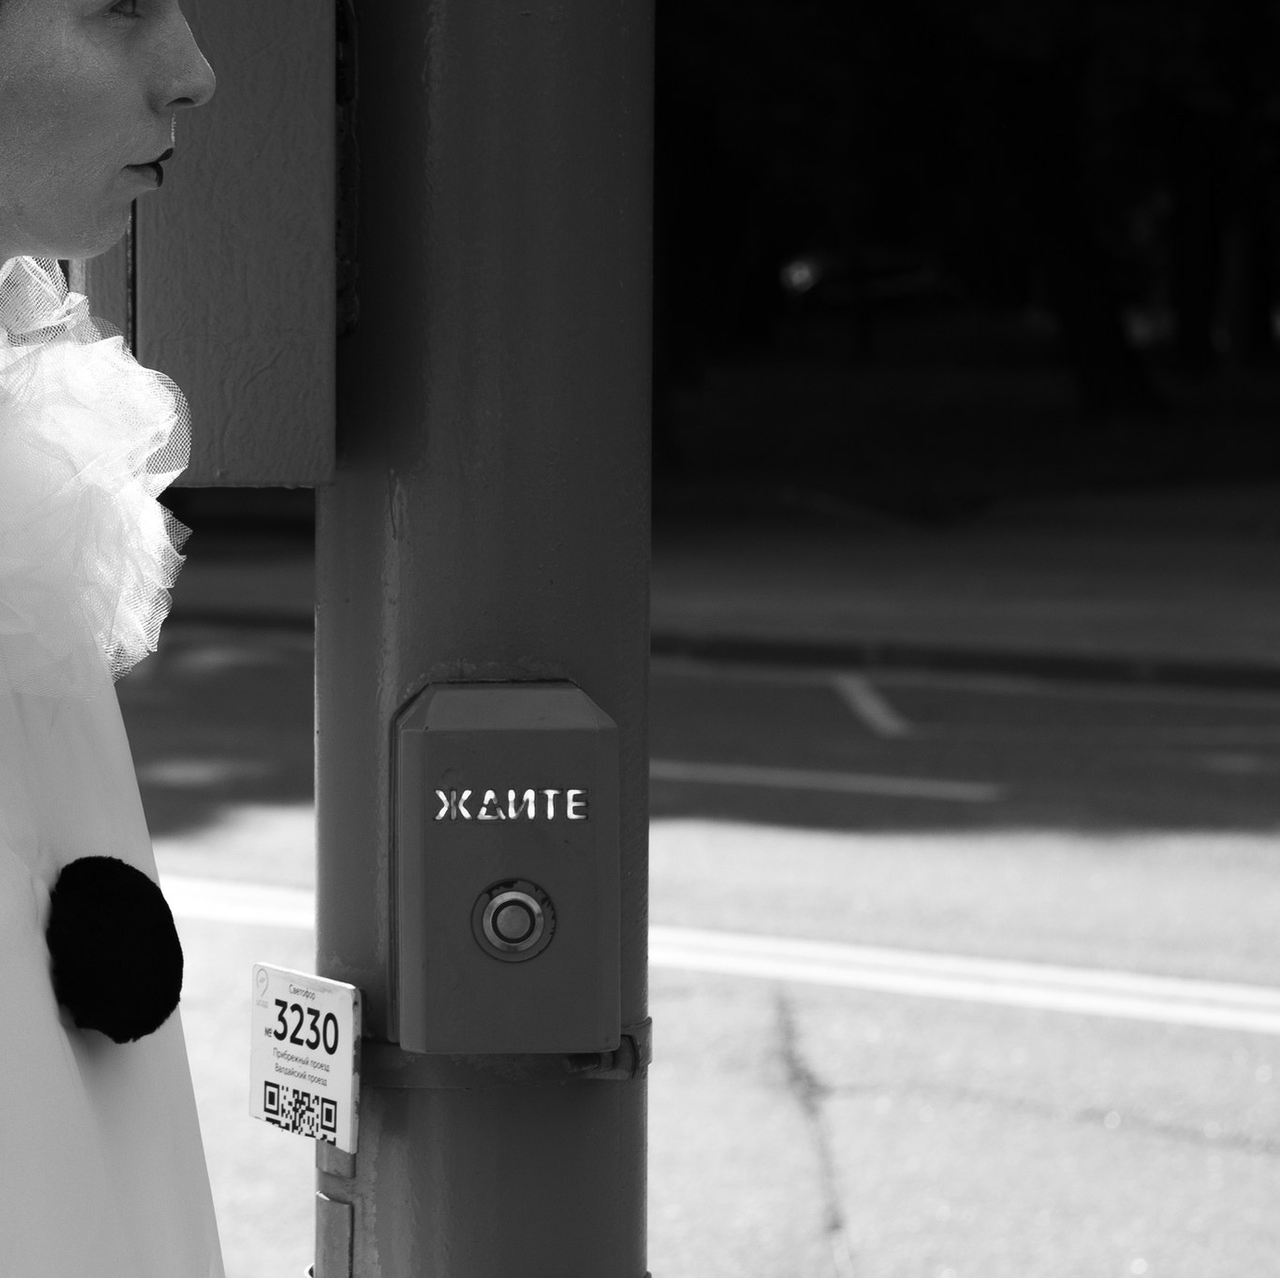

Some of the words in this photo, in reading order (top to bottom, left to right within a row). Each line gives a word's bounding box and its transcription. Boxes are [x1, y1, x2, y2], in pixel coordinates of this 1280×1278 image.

[433, 788, 588, 820] ЖДИТЕ
[288, 984, 316, 1000] Светофор
[273, 998, 339, 1055] 3230
